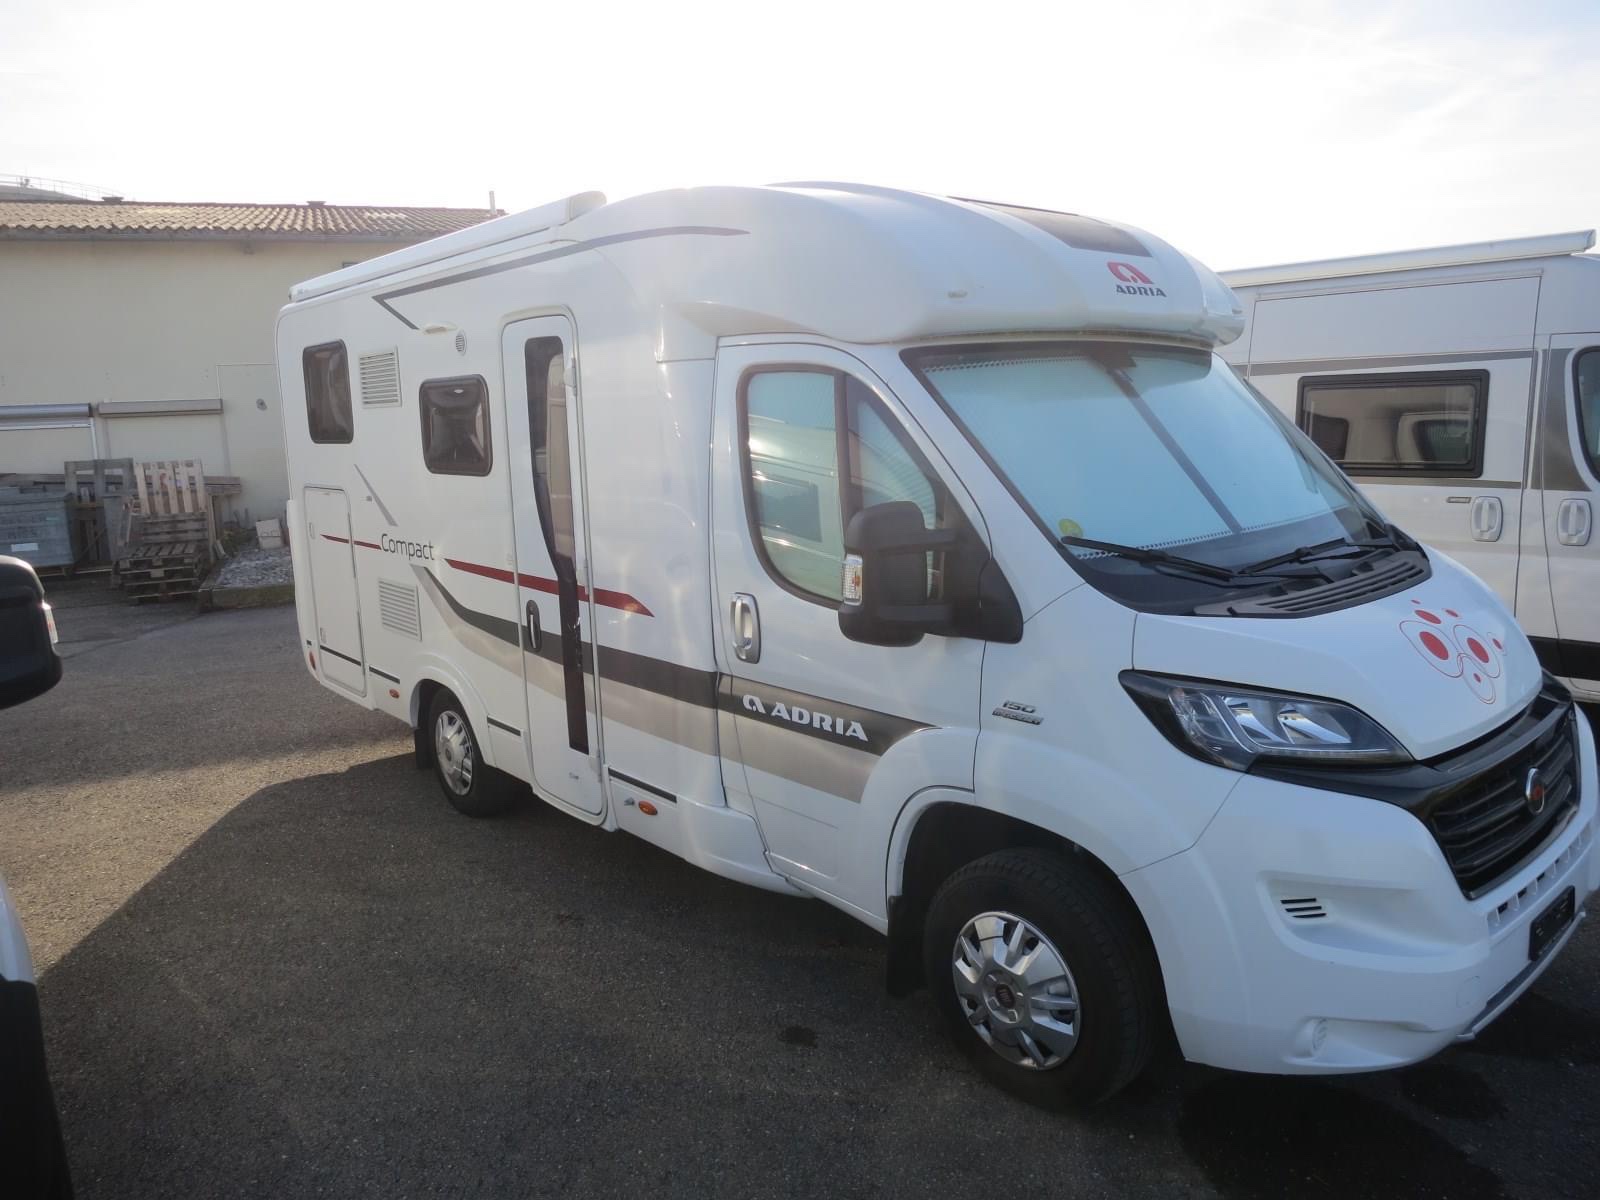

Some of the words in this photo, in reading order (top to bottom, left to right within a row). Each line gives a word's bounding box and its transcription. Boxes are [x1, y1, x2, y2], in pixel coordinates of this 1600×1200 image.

[1116, 284, 1167, 298] ADRIA
[381, 533, 434, 561] Compact
[771, 701, 869, 742] ADRIA
